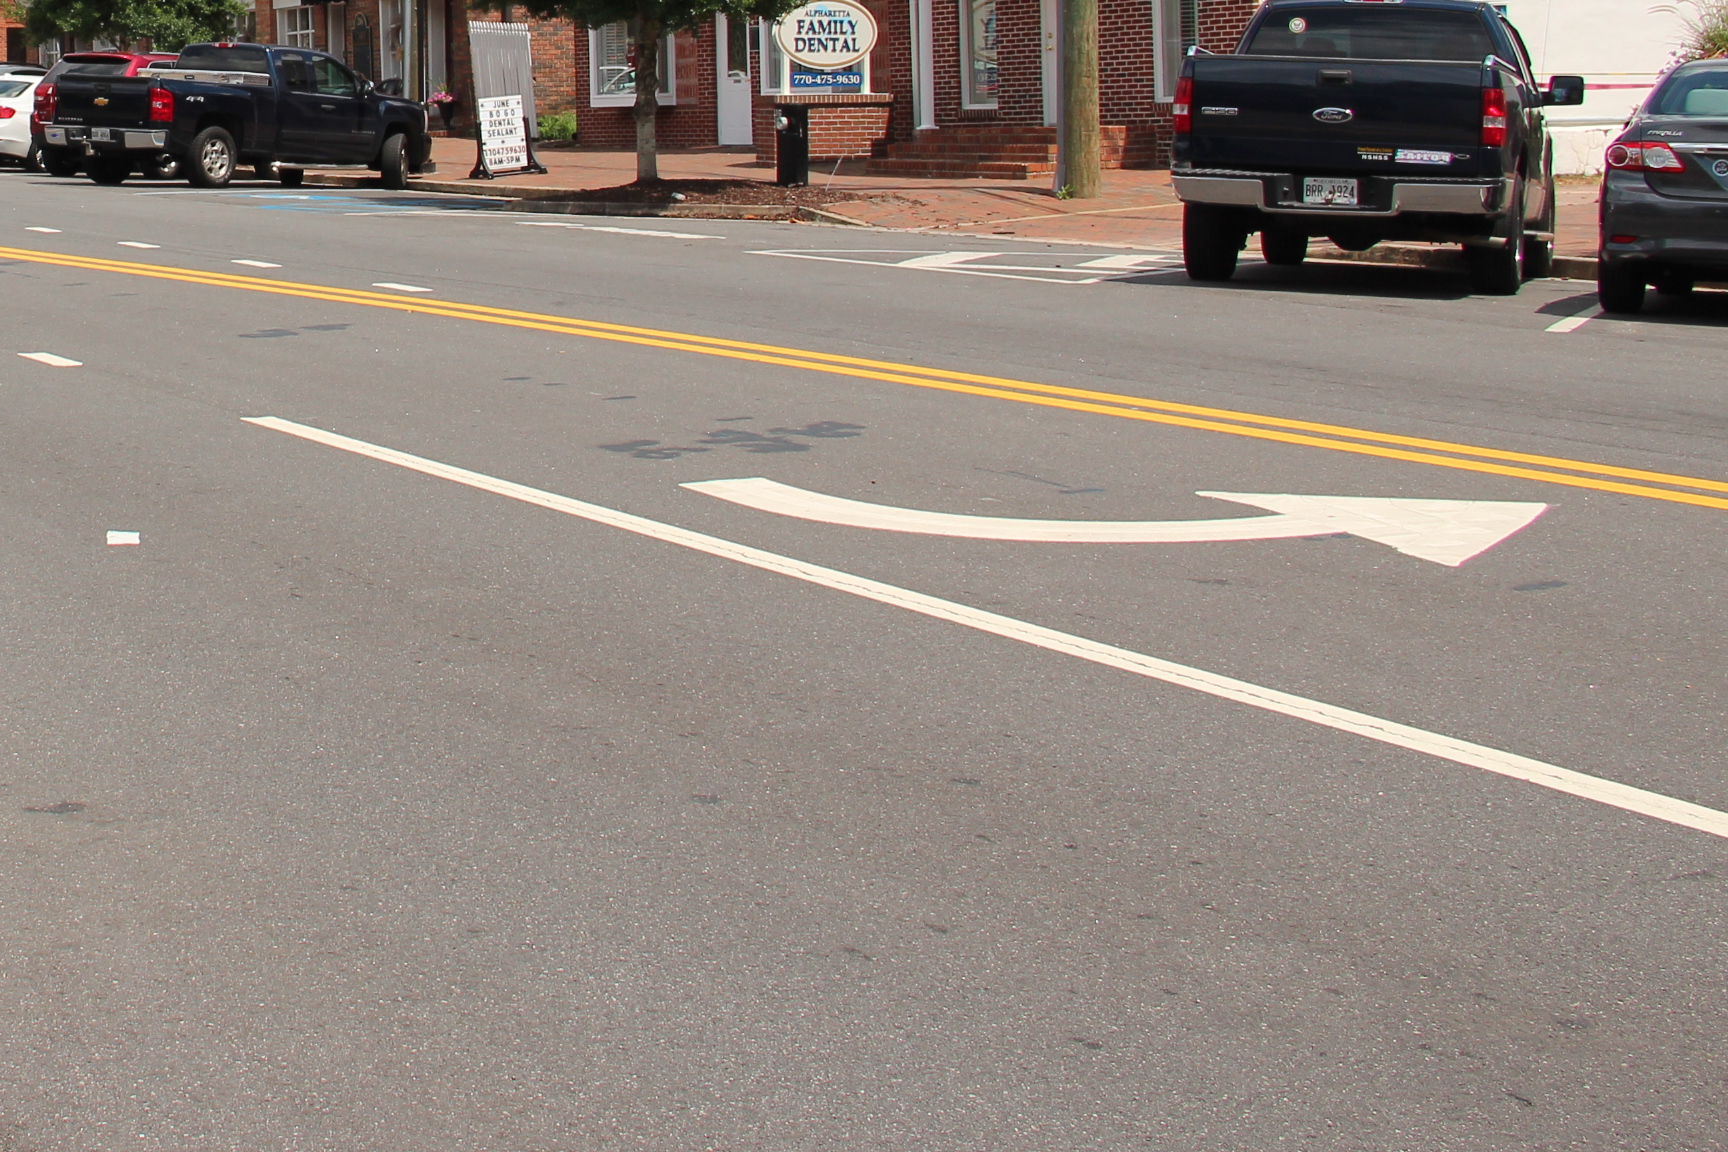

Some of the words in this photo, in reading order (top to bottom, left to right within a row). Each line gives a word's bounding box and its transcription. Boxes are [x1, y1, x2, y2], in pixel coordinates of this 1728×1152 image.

[796, 19, 859, 35] FAMILY
[794, 37, 861, 53] DENTAL
[793, 74, 860, 85] 770-475-9630
[493, 99, 510, 108] JUNE
[1320, 110, 1343, 120] Ford
[489, 118, 515, 128] DENTAL
[487, 128, 518, 138] SEALANT
[488, 156, 521, 166] 8AM-5PM
[1305, 184, 1324, 197] BRR
